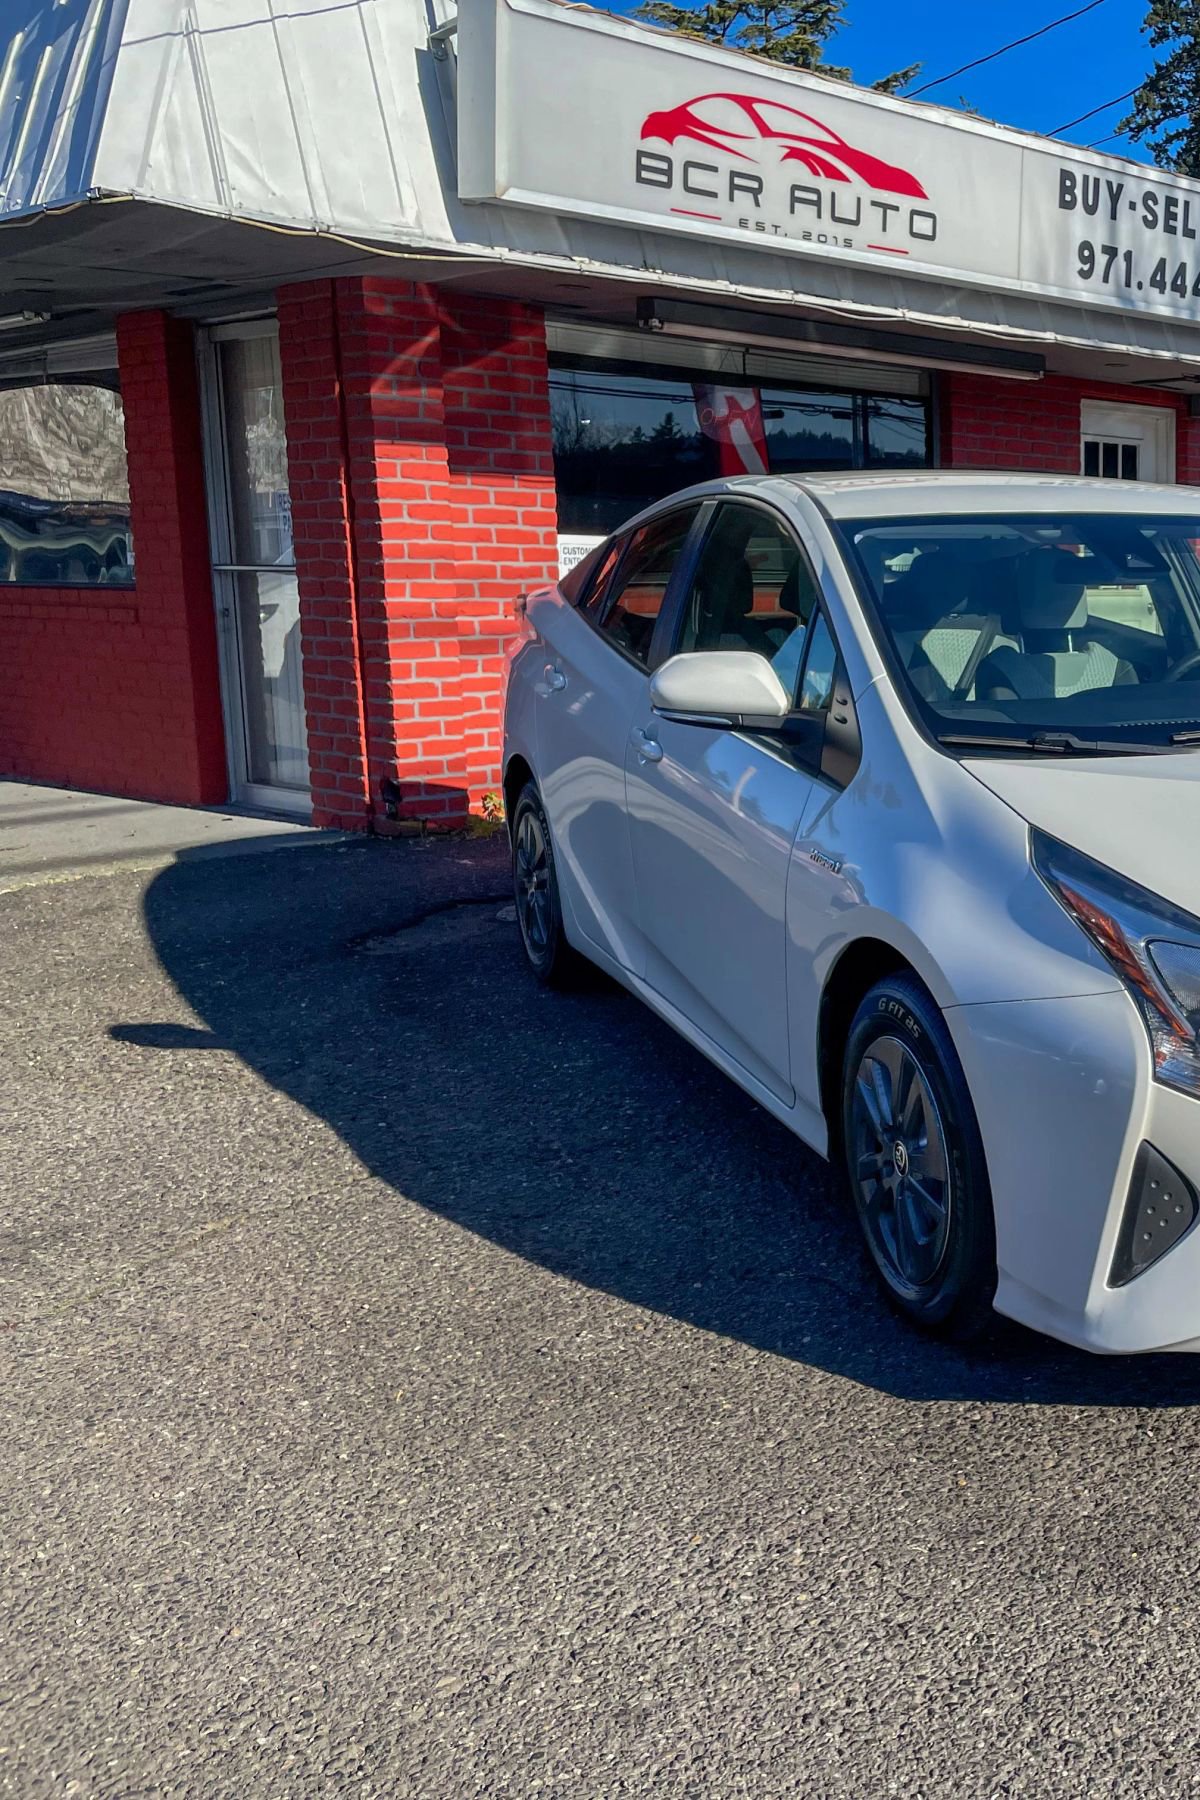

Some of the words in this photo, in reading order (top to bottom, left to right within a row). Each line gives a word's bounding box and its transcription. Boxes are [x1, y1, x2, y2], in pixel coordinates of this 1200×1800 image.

[636, 149, 764, 208] BCR
[790, 183, 937, 242] AUTO
[802, 231, 853, 248] 2015
[878, 997, 887, 1010] G
[888, 1001, 906, 1019] FIT
